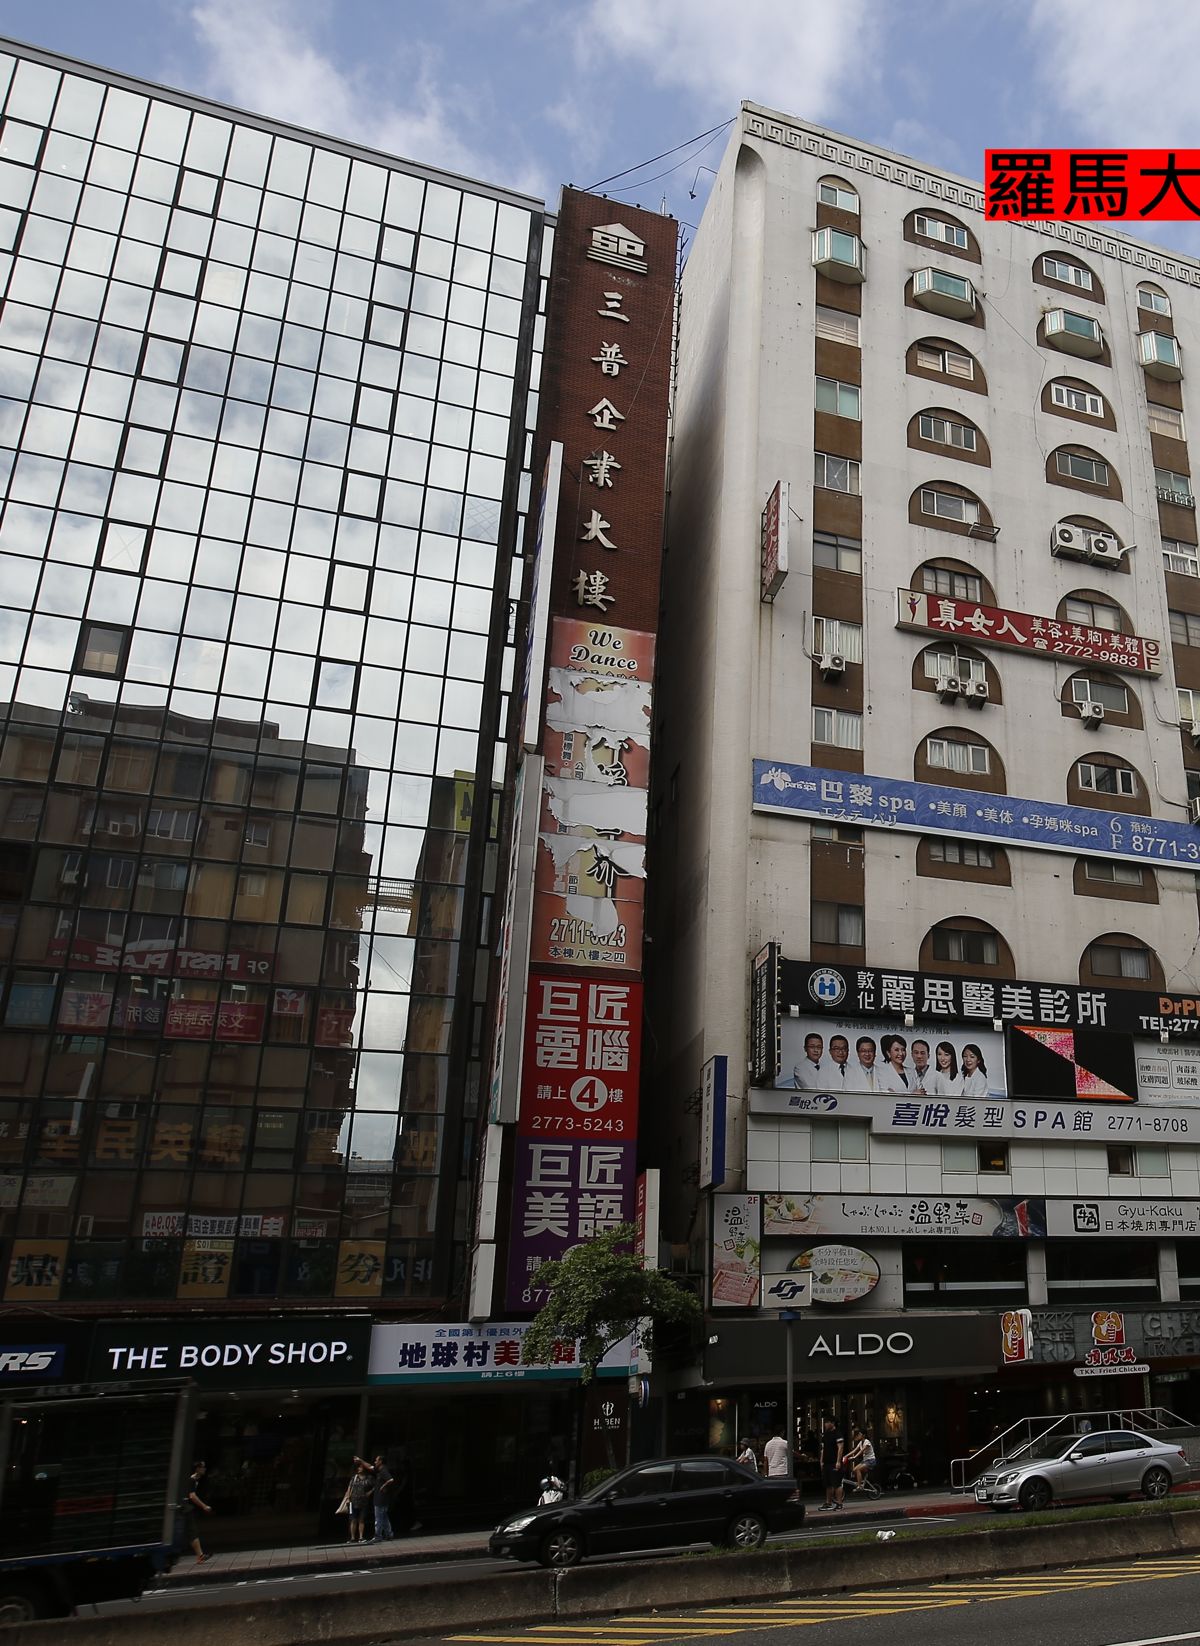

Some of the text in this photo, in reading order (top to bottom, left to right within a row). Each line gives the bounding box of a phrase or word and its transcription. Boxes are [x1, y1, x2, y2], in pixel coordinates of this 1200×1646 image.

[572, 291, 630, 612] 三普企業大樓
[932, 600, 1028, 644] 真女人
[589, 629, 623, 650] We
[571, 645, 638, 670] Dance
[1053, 642, 1138, 667] 2772-9883
[821, 779, 916, 813] 巴黎 spa
[550, 946, 625, 964] 本棟八樓之四
[537, 980, 630, 1026] 巨匠
[857, 971, 875, 1010] 敦化
[881, 973, 1107, 1026] 麗思醫美診所
[536, 1025, 630, 1072] 電腦
[532, 1116, 624, 1132] 2773-5243
[1108, 1116, 1189, 1133] 2771-8708
[526, 1143, 624, 1190] 巨匠
[747, 1196, 758, 1204] 2F
[1118, 1204, 1183, 1218] Gyu-Kaku
[524, 1192, 624, 1238] 美語
[108, 1341, 347, 1370] THE BODY SHOP
[808, 1332, 914, 1357] ALDO
[1085, 1346, 1137, 1366] 頂呱呱
[1099, 1367, 1117, 1375] Fried
[754, 1401, 778, 1409] ALDO
